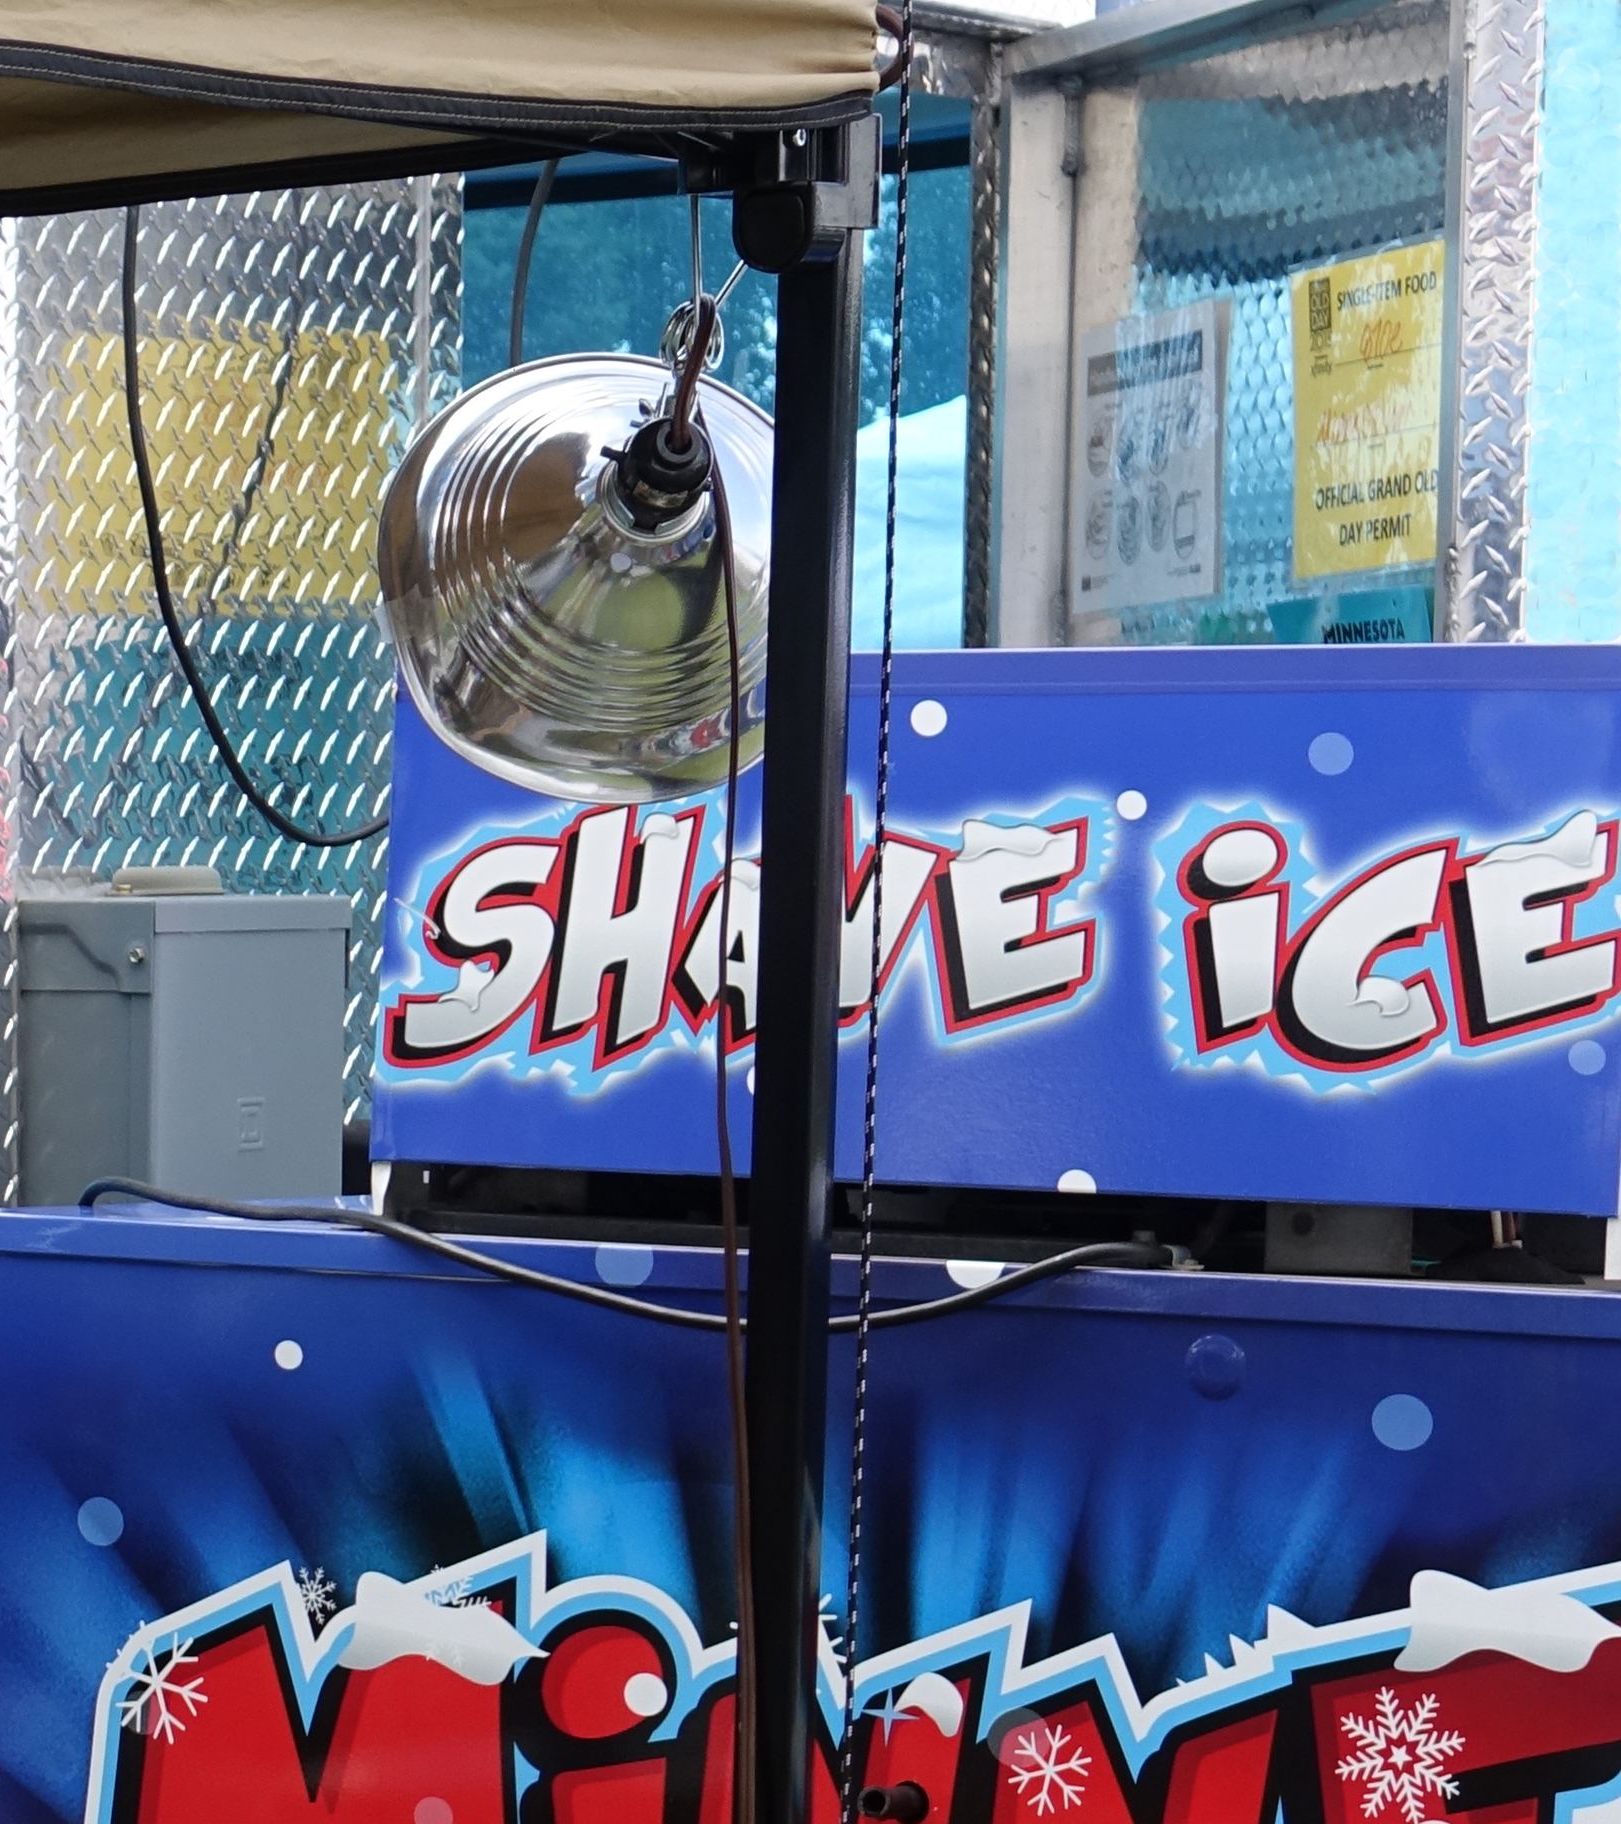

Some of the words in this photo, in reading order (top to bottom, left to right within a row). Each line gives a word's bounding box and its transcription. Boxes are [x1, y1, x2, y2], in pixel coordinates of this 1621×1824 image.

[1336, 278, 1402, 312] SINGLE-ITEM
[1404, 270, 1437, 296] FOOD
[1315, 481, 1365, 511] OFFICIAL
[1367, 473, 1412, 501] GRAND
[1414, 469, 1439, 494] OLD
[1339, 521, 1363, 547] DAY
[1365, 513, 1413, 541] PERMIT
[1321, 616, 1406, 644] MINNESOTA
